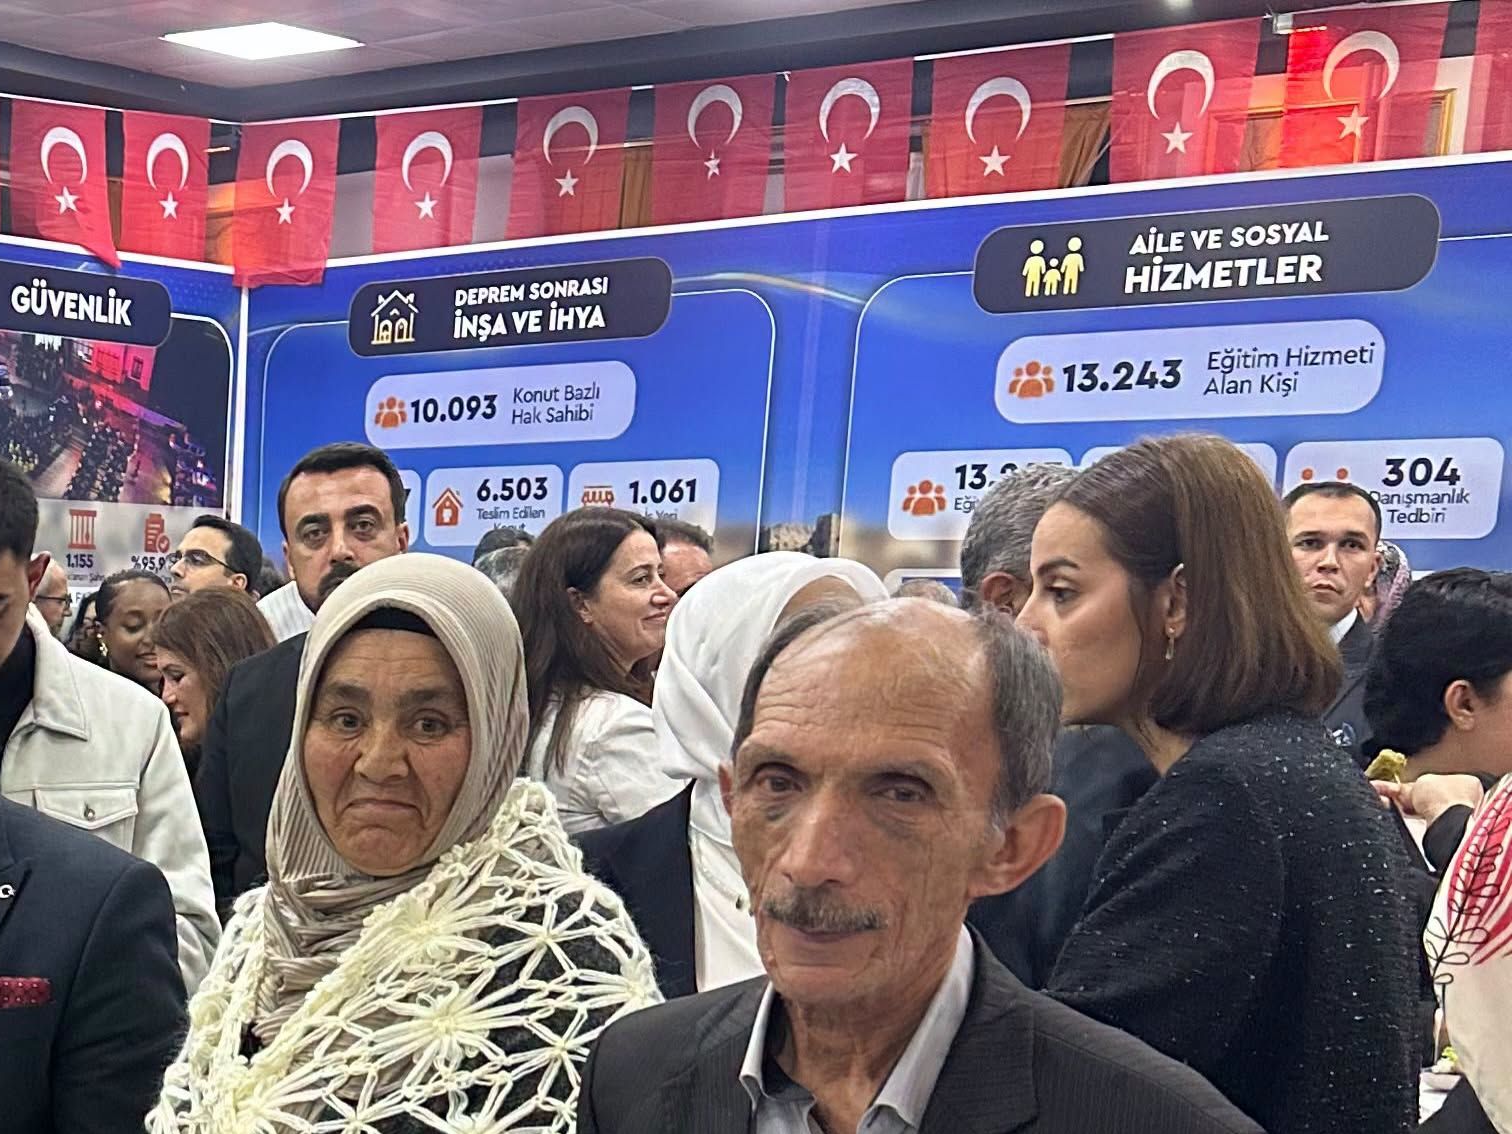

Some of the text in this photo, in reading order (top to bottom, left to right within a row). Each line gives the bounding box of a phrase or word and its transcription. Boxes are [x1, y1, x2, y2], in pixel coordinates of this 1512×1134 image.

[1128, 221, 1330, 255] AİLE VE SOSYAL
[1124, 254, 1323, 294] HİZMETLER
[11, 278, 133, 327] GÜVENLİK
[454, 276, 609, 307] DEPREM SONRASI
[453, 301, 606, 342] İNŞA VE İHYA
[1206, 341, 1376, 375] Eğitim Hizmeti
[1062, 358, 1184, 392] 13.243
[1203, 371, 1299, 396] Alan Kişi
[513, 381, 601, 403] Konut Bazlı
[410, 394, 498, 423] 10.093
[512, 403, 595, 424] Hak Sahibi
[1382, 457, 1461, 487] 304
[476, 476, 548, 502] 6.503
[628, 478, 697, 504] 1.061
[1369, 488, 1470, 508] Danışmanlık
[476, 506, 546, 520] Teslim Edilen
[1386, 507, 1447, 524] Tedbiri
